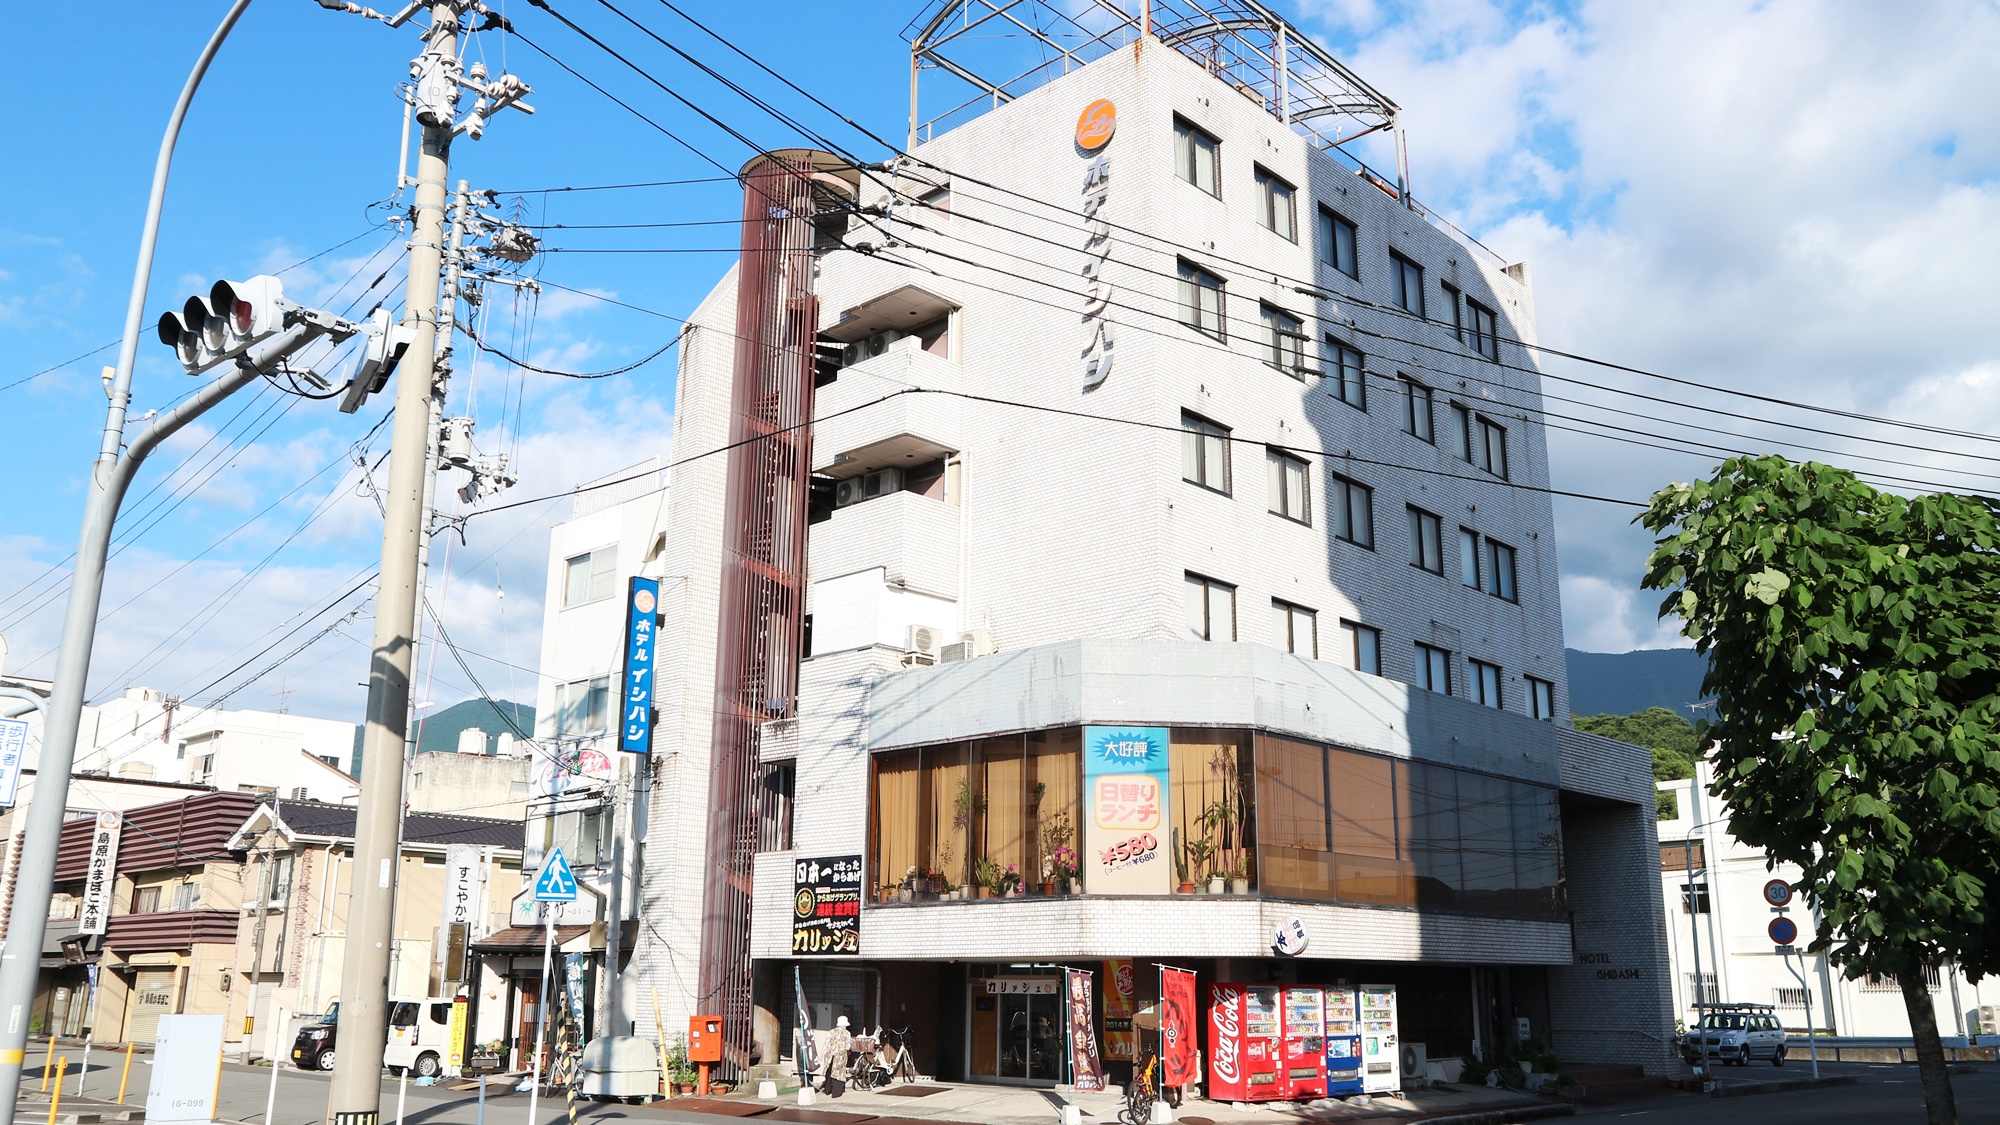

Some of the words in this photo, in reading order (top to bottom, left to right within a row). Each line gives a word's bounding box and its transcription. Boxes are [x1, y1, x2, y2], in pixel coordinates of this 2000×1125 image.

[3, 725, 24, 767] 歩行者
[1104, 741, 1148, 758] 大好評
[1100, 782, 1156, 802] 日替り
[1100, 803, 1157, 823] ランチ
[1098, 832, 1158, 867] ¥580
[796, 861, 832, 884] 日本一
[833, 860, 860, 871] になった
[83, 832, 111, 930] 島原かまぼこ本舗
[832, 871, 861, 883] からあげ
[454, 866, 471, 922] すこやか
[1770, 886, 1787, 899] 30
[1581, 953, 1611, 964] HOTEL
[1597, 969, 1639, 980] ISHIBASHI
[1212, 984, 1240, 1085] Coca-Cola
[171, 1099, 204, 1108] 16-099
